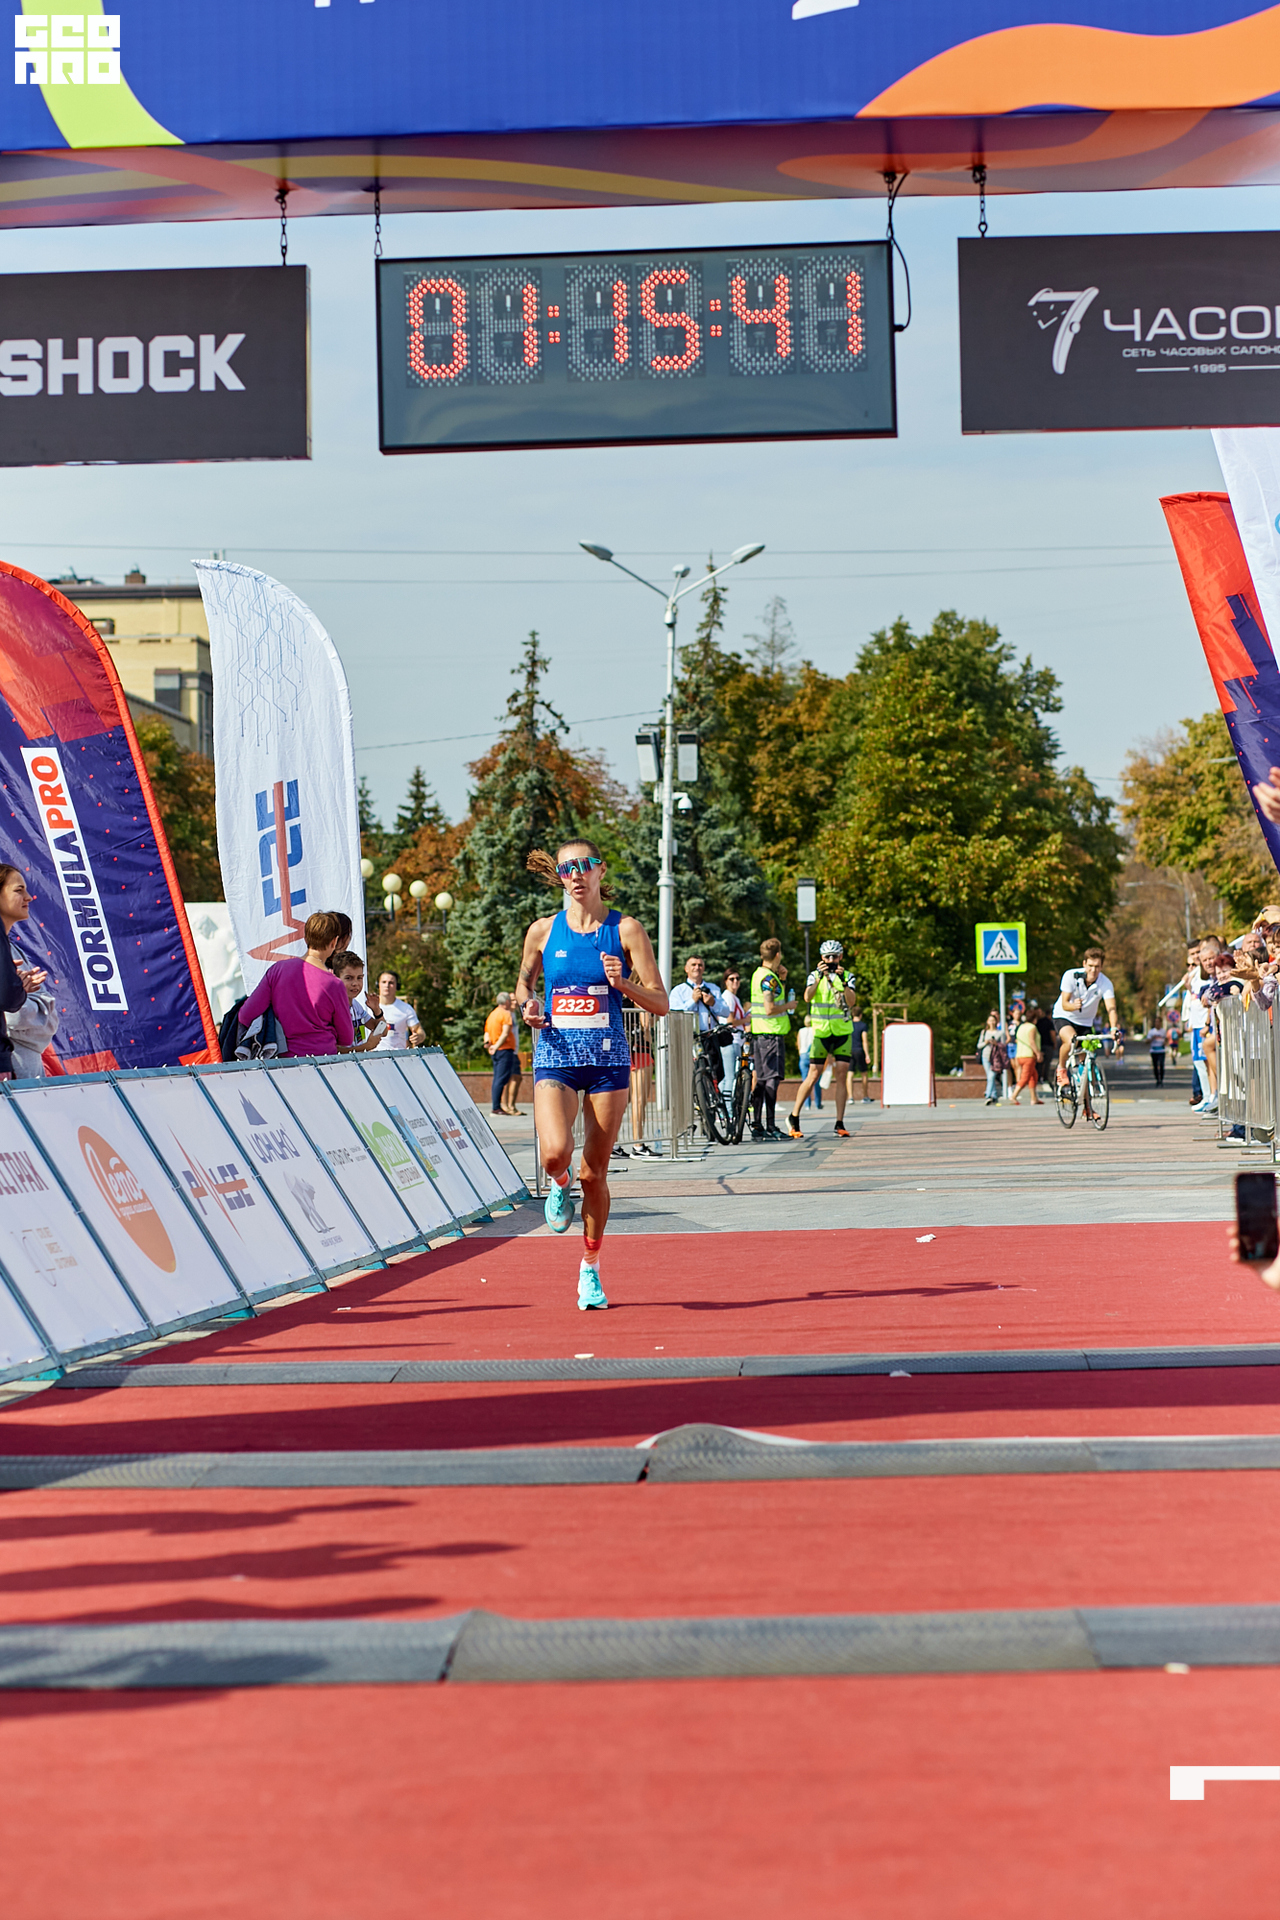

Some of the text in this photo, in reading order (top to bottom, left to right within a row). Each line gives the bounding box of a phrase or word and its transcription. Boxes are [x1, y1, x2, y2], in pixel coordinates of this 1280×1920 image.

[408, 268, 864, 379] 01:15:41
[1103, 305, 1280, 342] ЧАСО
[1122, 348, 1157, 358] СЕТЬ
[1160, 346, 1227, 357] ЧАСОВЫХ
[1192, 363, 1227, 374] 1995
[555, 998, 595, 1013] 2323
